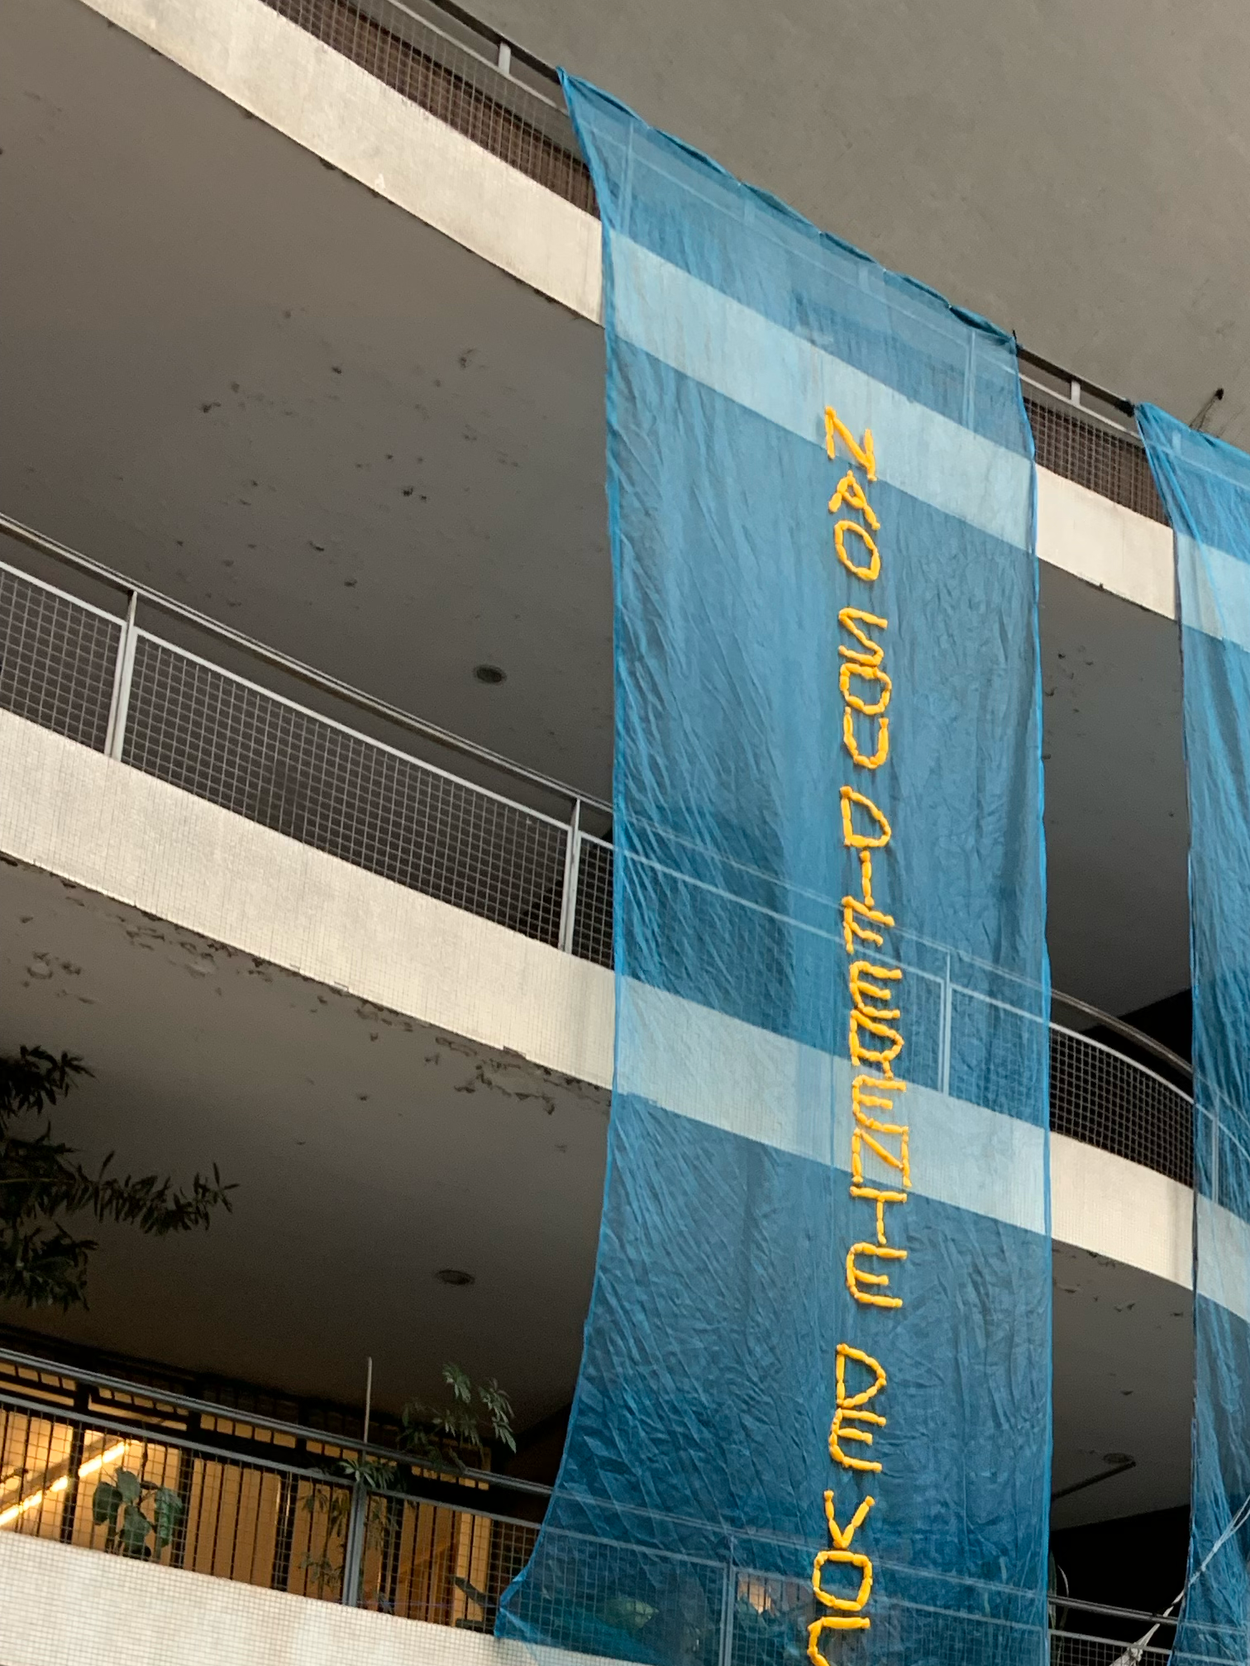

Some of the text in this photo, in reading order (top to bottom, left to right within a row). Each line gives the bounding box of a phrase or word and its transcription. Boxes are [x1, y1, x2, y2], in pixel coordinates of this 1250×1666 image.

[838, 606, 893, 770] SOU
[839, 784, 912, 1309] DIFERENTE
[828, 1342, 888, 1473] DE
